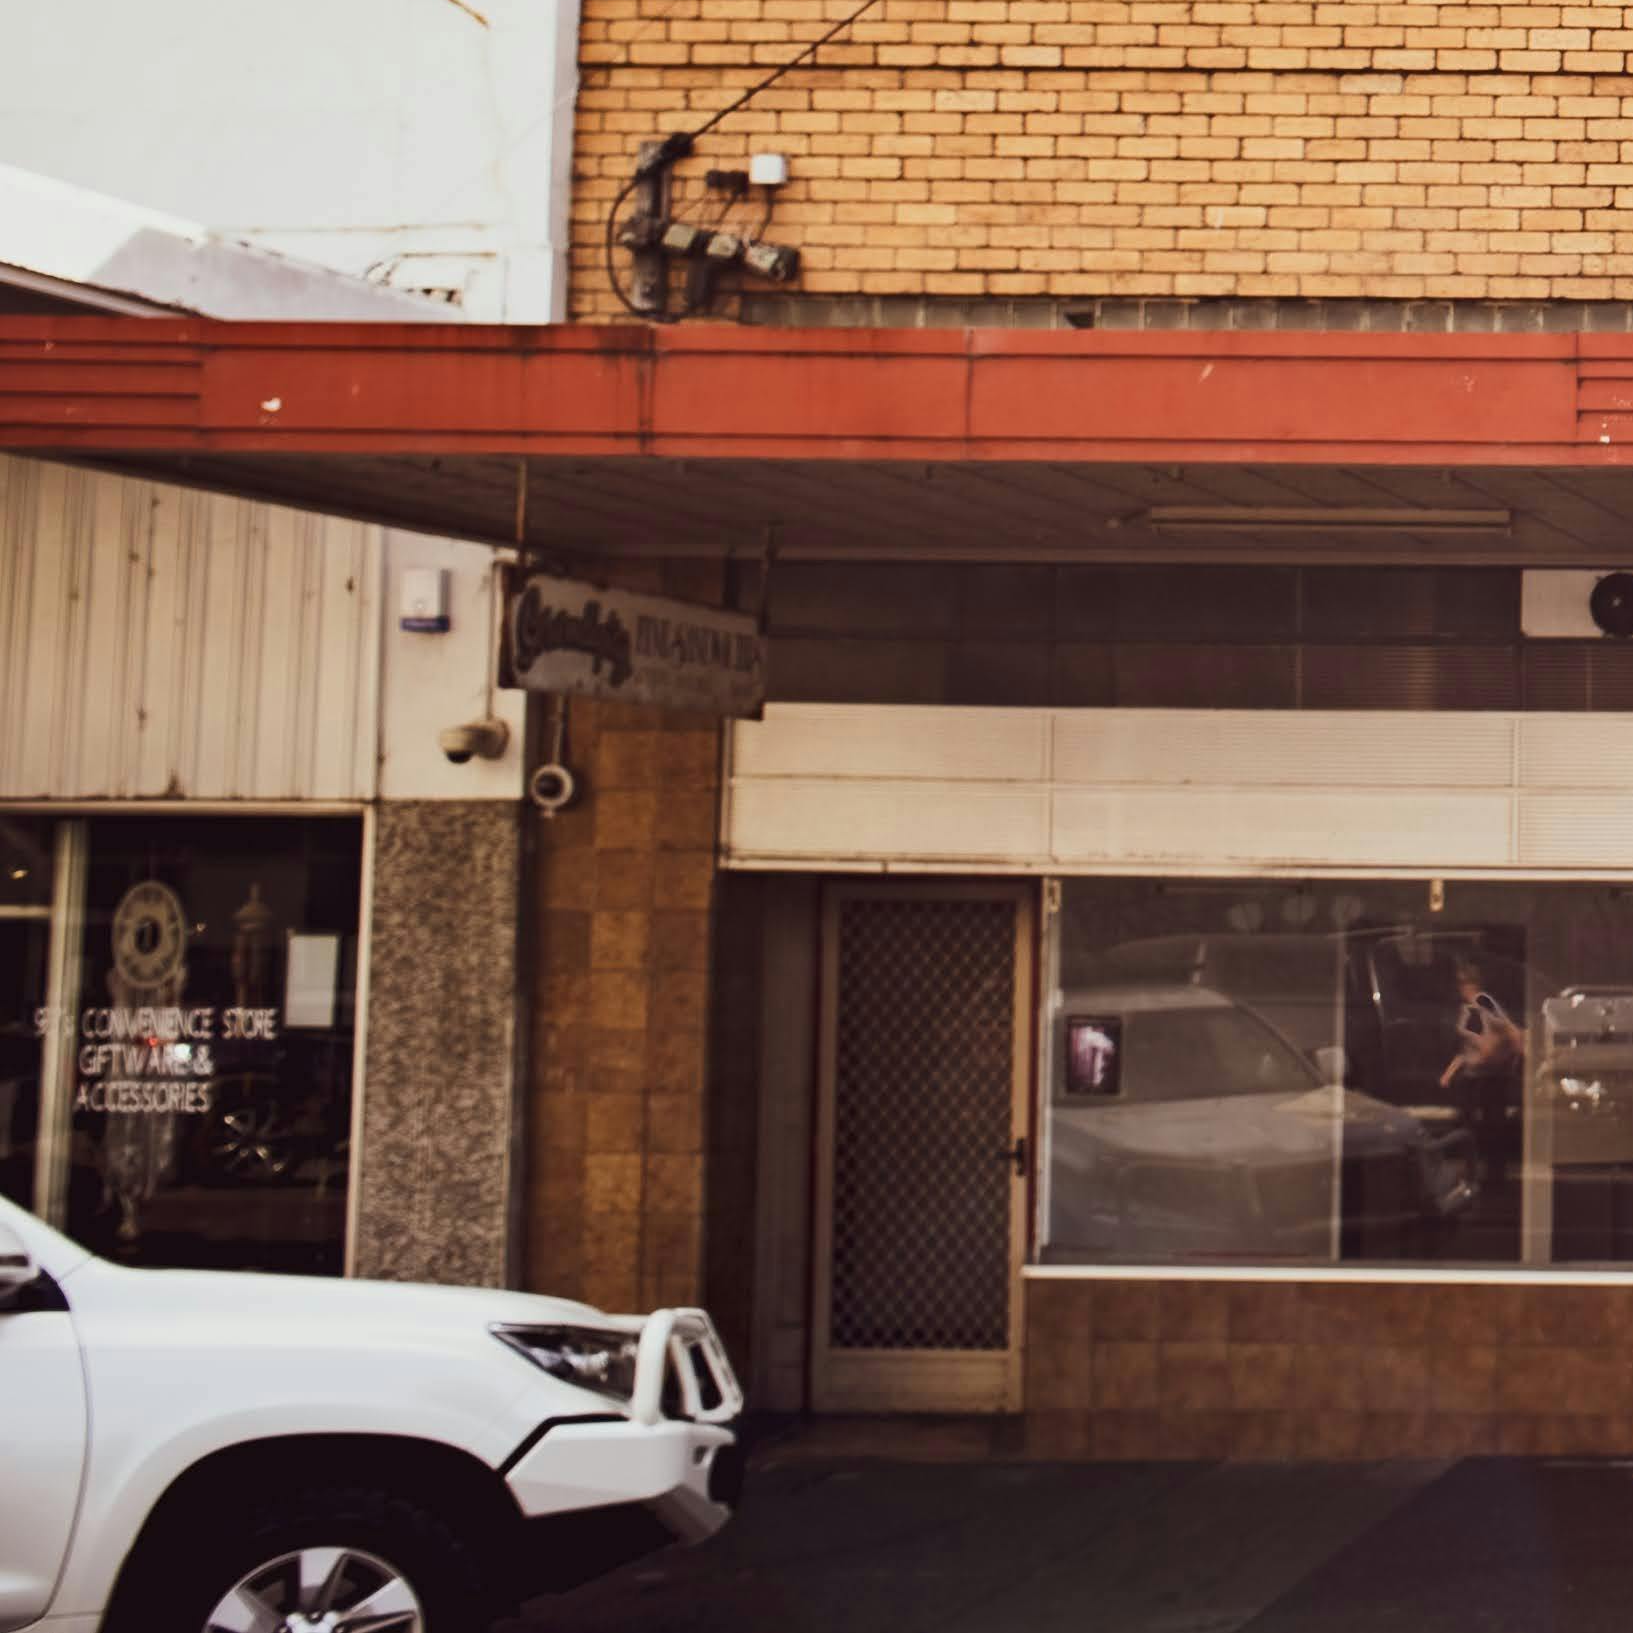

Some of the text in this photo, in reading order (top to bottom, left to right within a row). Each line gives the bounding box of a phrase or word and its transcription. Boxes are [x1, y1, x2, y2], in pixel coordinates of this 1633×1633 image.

[81, 1006, 215, 1039] CONVENIENCE
[222, 1007, 278, 1040] STORE
[193, 1044, 215, 1076] &
[75, 1081, 213, 1113] ACCESSORIES
